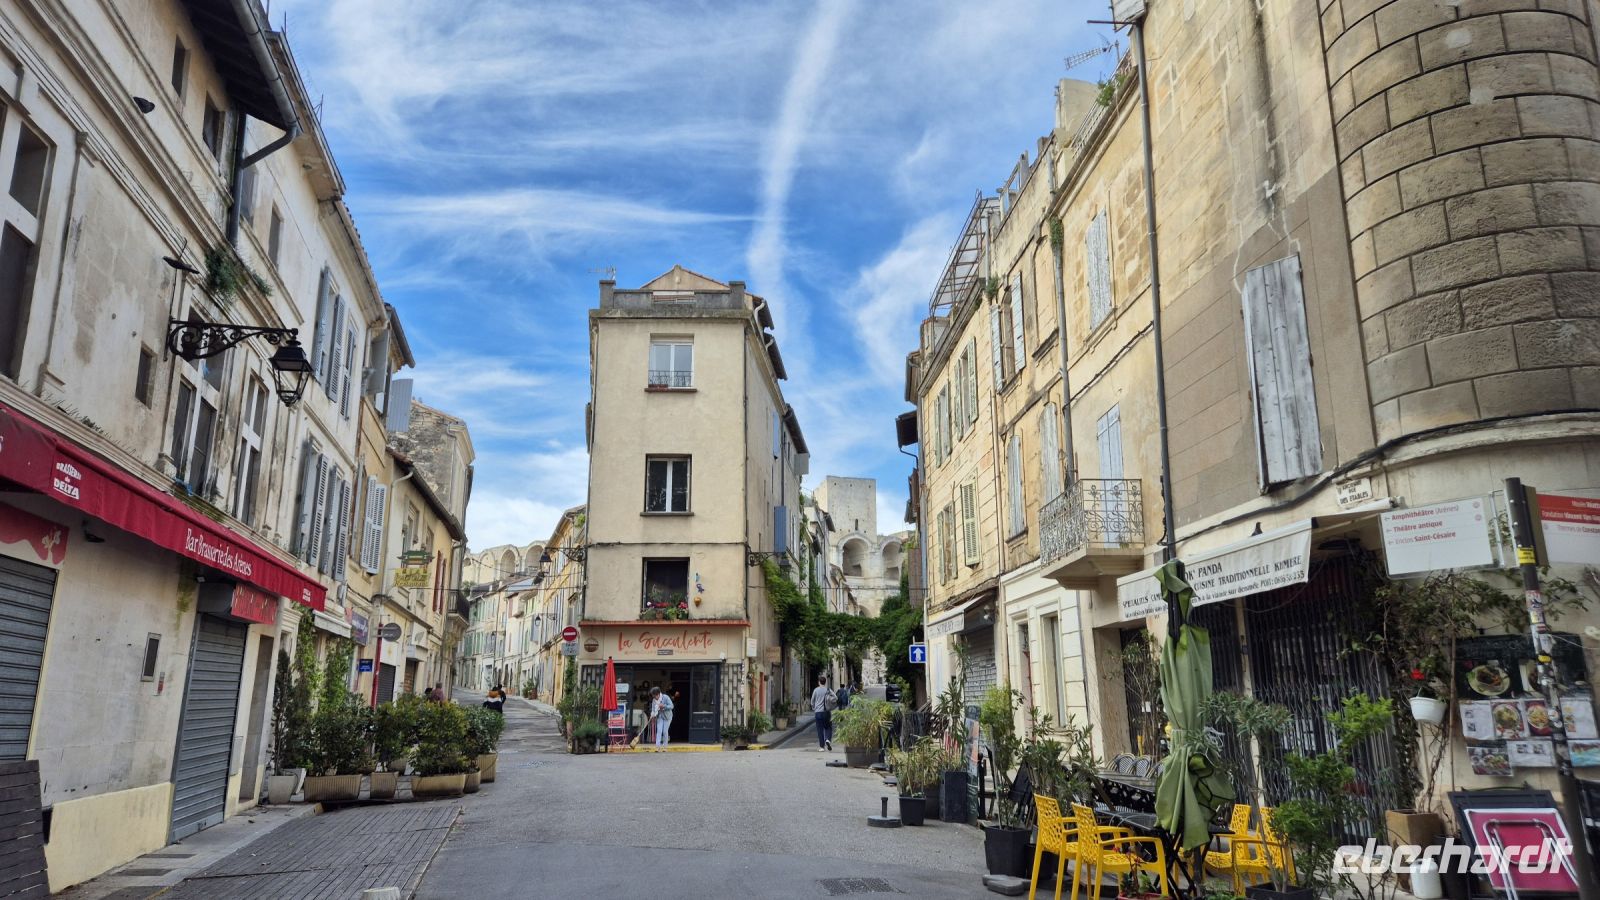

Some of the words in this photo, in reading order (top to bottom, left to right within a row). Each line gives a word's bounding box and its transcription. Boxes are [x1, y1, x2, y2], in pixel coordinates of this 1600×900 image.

[53, 477, 80, 497] DELTA
[1391, 509, 1434, 521] Amphithéâtre
[1434, 504, 1459, 515] (Arènes)
[1393, 524, 1417, 533] Théâtre
[1418, 520, 1443, 530] antique
[1414, 531, 1456, 542] Saint-Césaire
[185, 527, 199, 553] Bar
[197, 534, 224, 564] Brasserie
[1193, 578, 1215, 592] CUISINE
[1218, 564, 1270, 586] TRADITIONNELLE
[1198, 562, 1223, 578] PANDA
